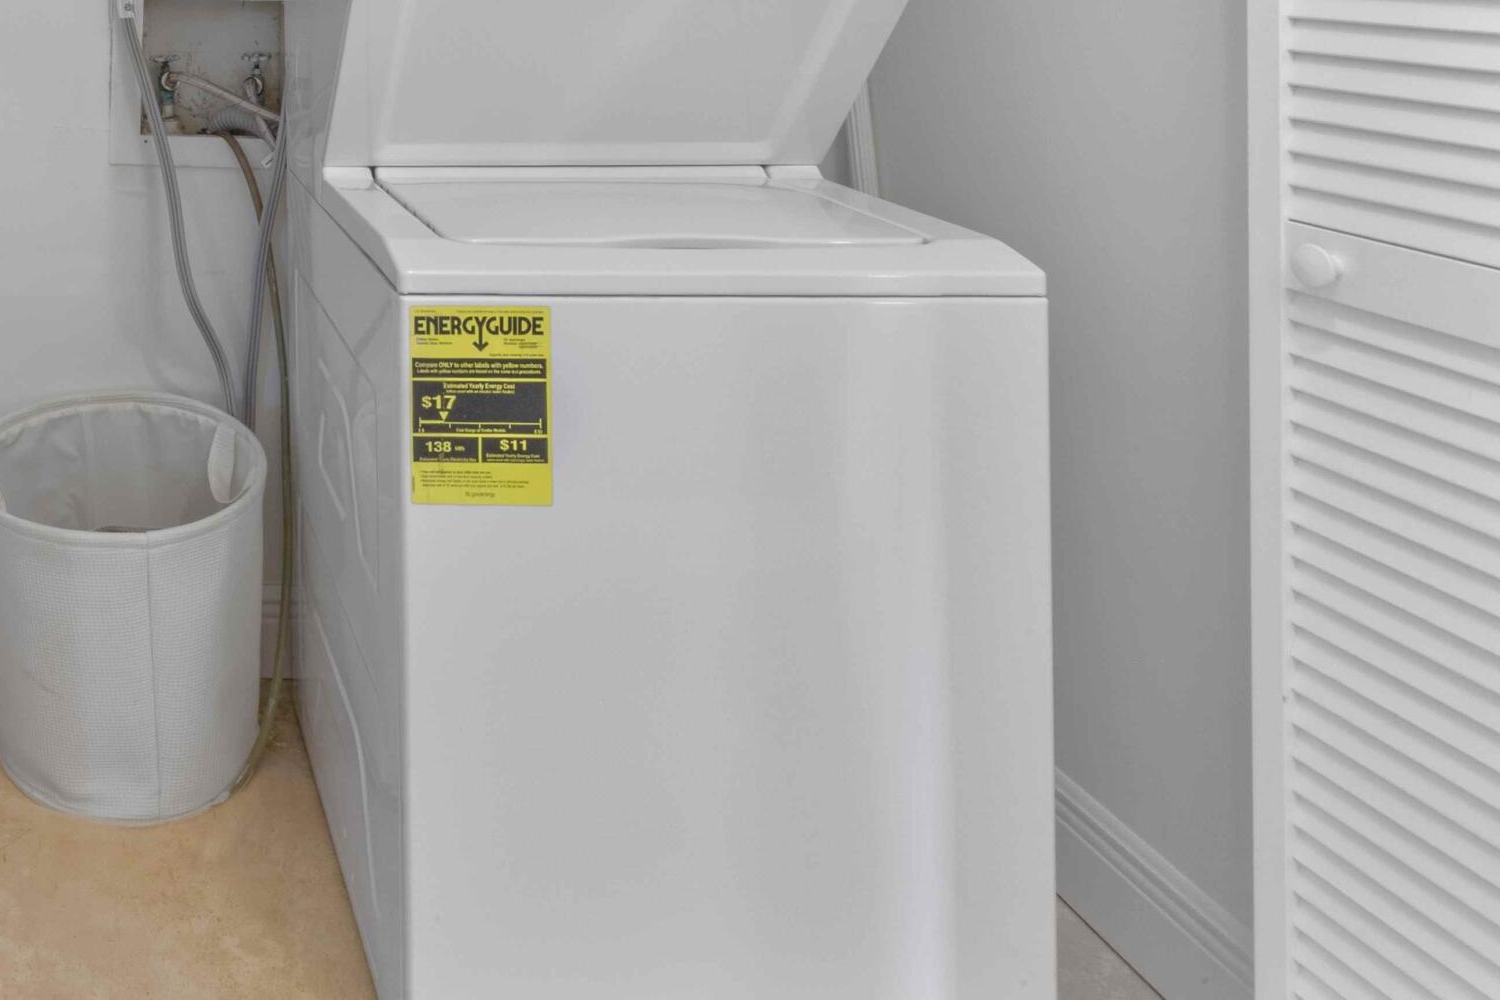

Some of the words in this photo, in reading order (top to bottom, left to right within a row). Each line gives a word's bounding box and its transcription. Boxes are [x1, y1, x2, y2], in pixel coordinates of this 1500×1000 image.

[414, 316, 544, 336] ENERGYGUIDE
[421, 395, 457, 410] $17
[425, 441, 452, 453] 138
[500, 439, 528, 451] $11
